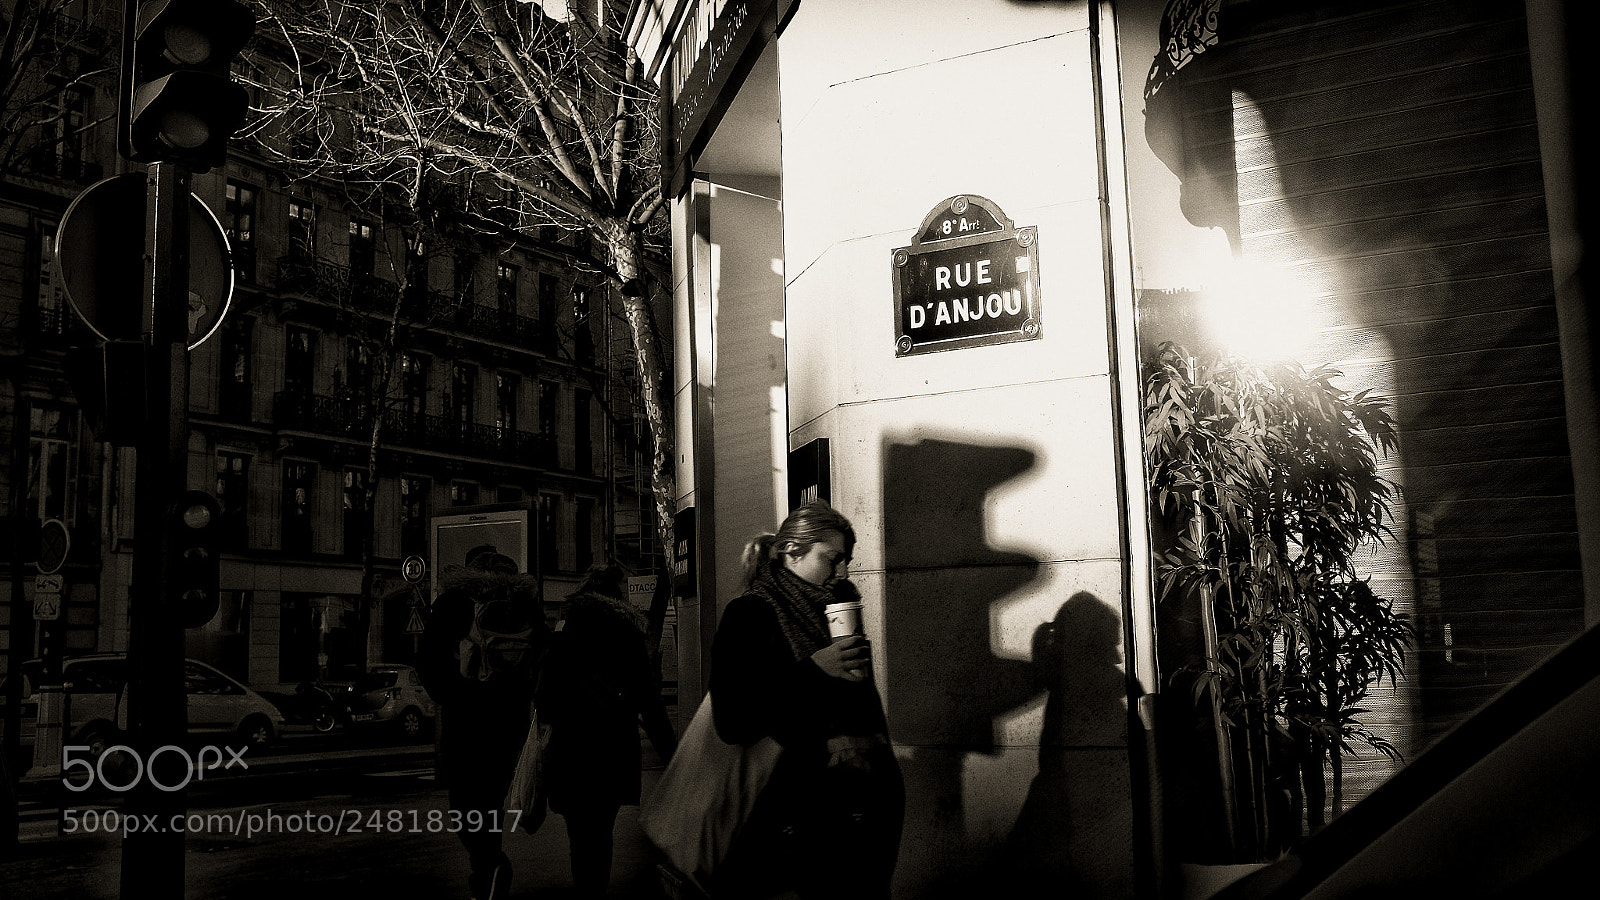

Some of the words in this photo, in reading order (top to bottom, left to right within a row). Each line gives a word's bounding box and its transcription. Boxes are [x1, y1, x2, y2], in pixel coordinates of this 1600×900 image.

[935, 259, 992, 291] RUE
[910, 290, 1022, 329] D'ANJOU
[408, 562, 421, 577] 30
